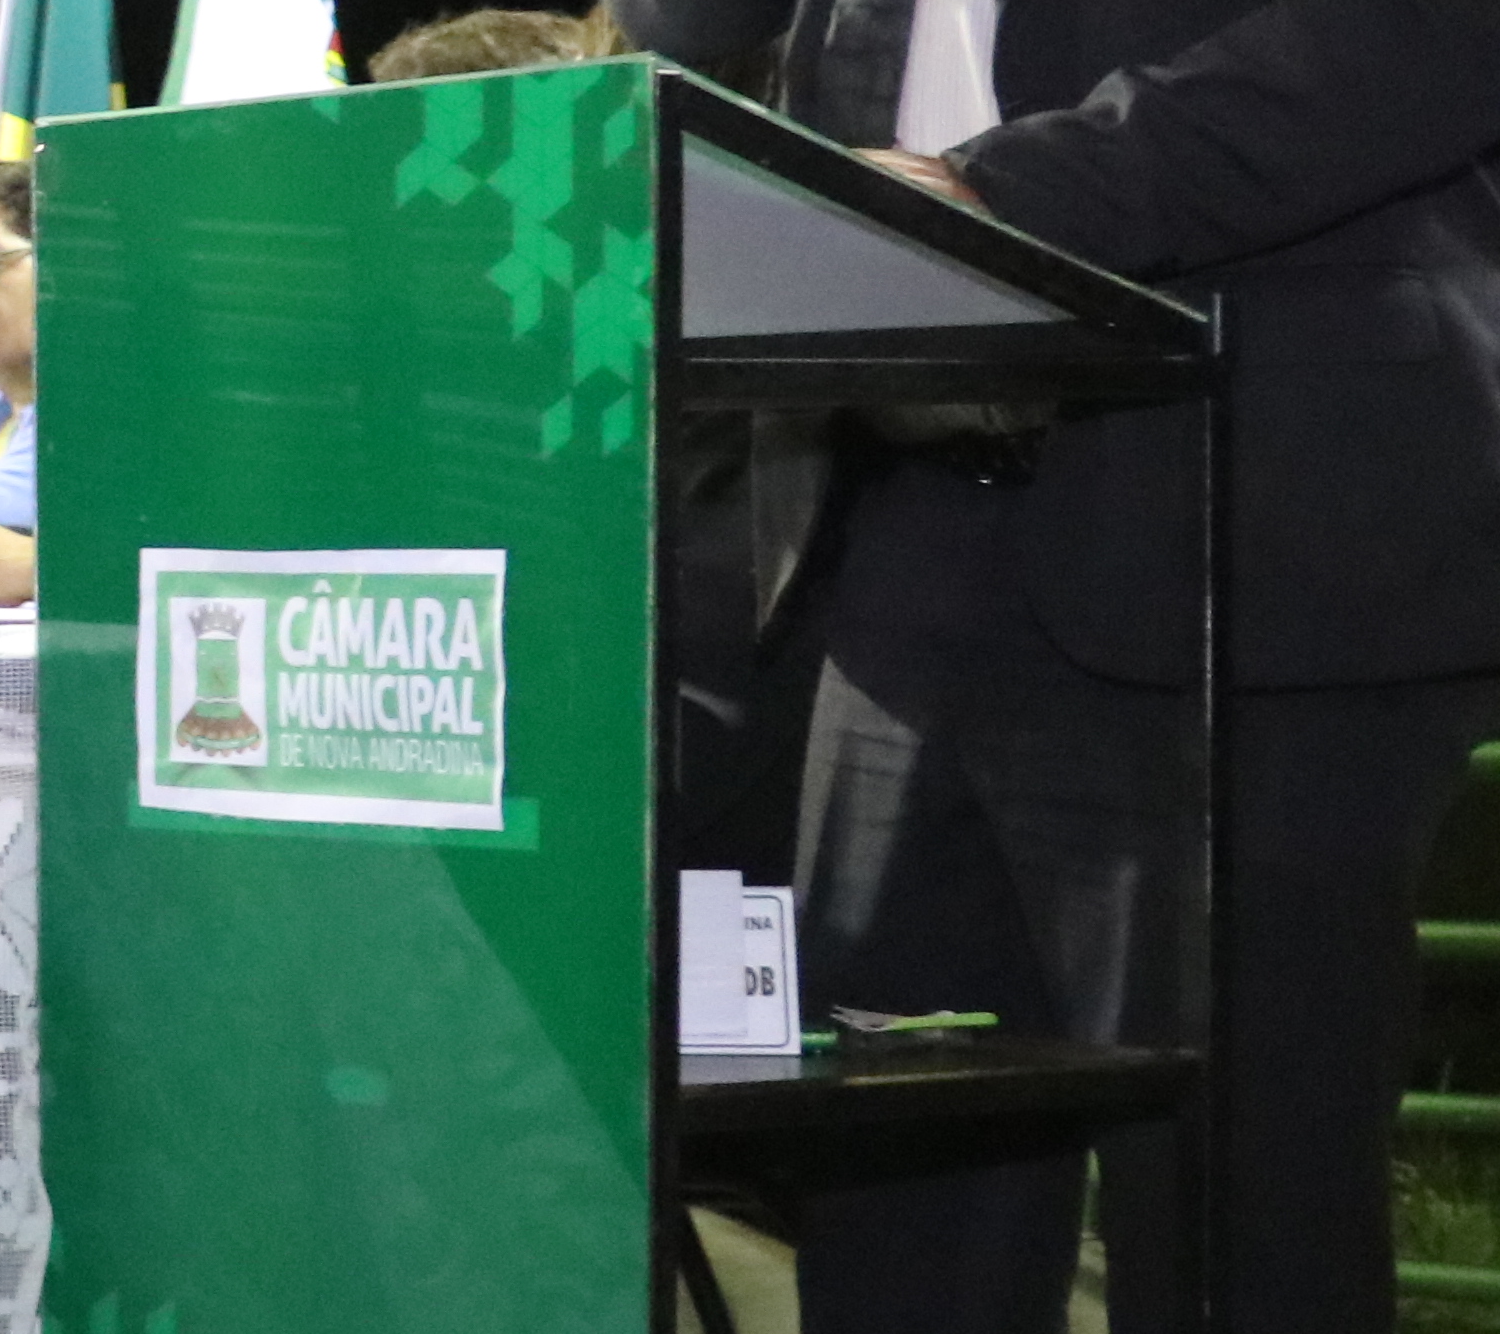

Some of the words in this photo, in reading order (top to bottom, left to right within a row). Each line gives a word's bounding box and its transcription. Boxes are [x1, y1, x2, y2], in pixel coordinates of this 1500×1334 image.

[278, 579, 483, 670] CÂMARA
[278, 672, 483, 734] MUNICIPAL
[280, 734, 303, 768] DE
[309, 736, 361, 770] NOVA
[369, 739, 483, 776] ANDRADINA
